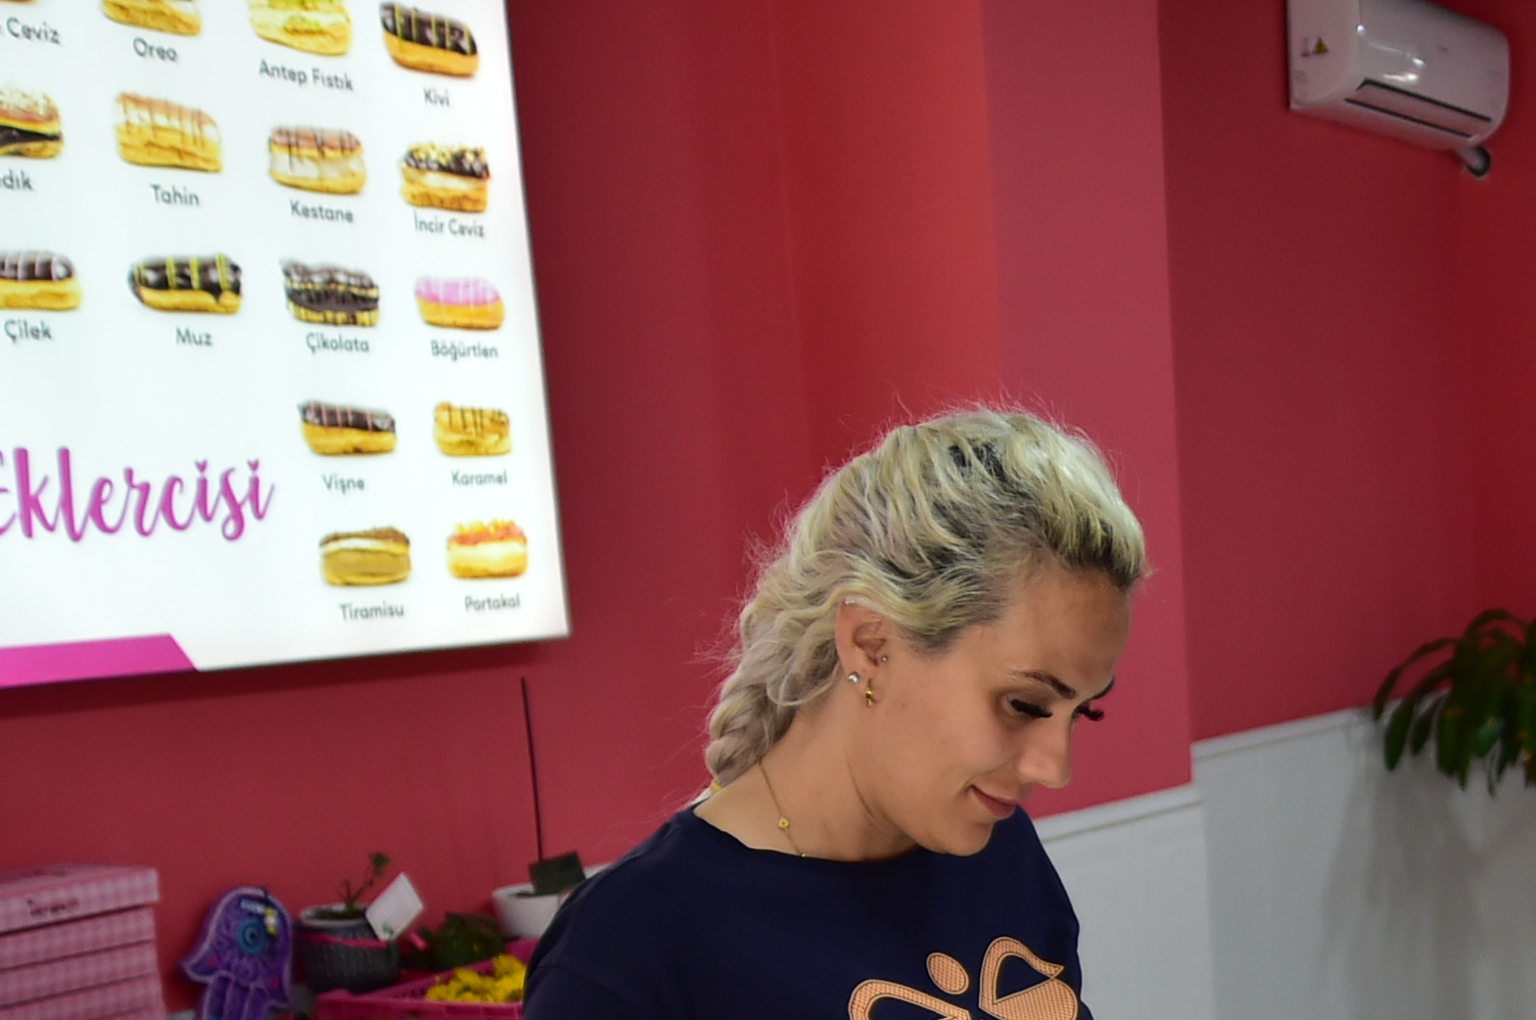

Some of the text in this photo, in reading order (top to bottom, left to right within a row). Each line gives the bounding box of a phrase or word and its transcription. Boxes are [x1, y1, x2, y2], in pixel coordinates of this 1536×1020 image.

[7, 17, 61, 44] Ceviz
[132, 37, 178, 62] Oreo
[259, 60, 307, 85] Antep
[424, 87, 450, 107] Kivi
[0, 168, 33, 191] dık
[150, 184, 199, 207] Tahin
[290, 200, 353, 224] Kestane
[449, 218, 484, 239] Ceviz
[4, 320, 52, 347] Çilek
[176, 326, 213, 348] Muz
[306, 332, 369, 356] Çikolata
[430, 340, 498, 362] Böğürtlen
[322, 474, 365, 493] Vişne
[451, 469, 507, 487] Karamel
[339, 603, 404, 621] Tiramisu
[464, 594, 520, 612] Portakal
